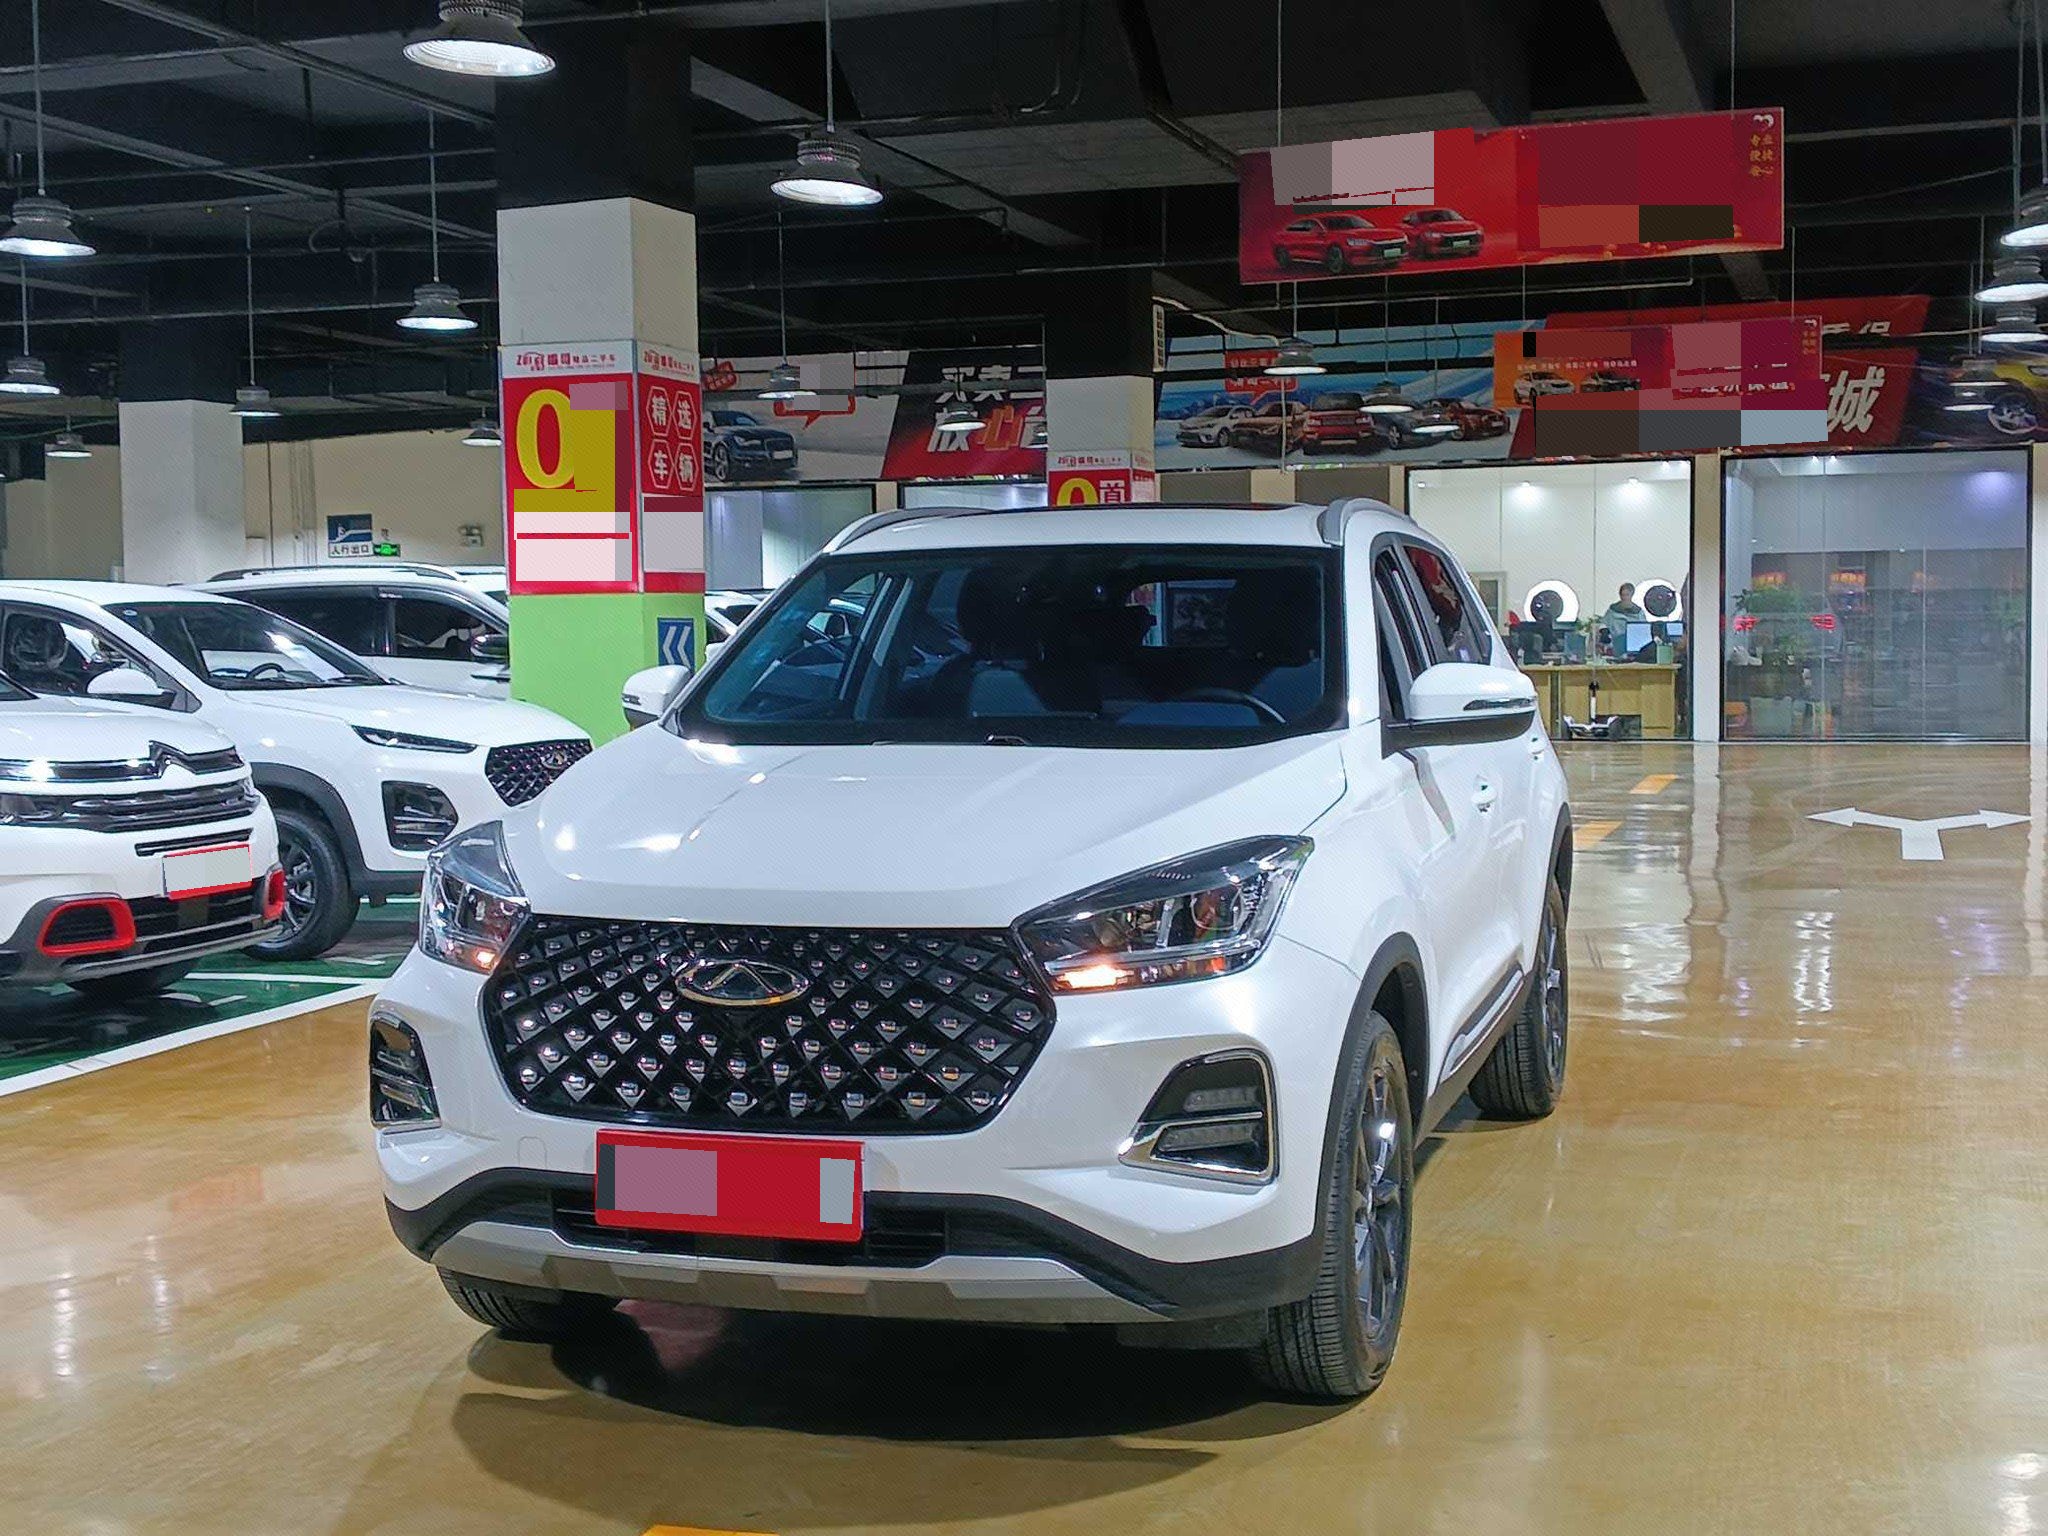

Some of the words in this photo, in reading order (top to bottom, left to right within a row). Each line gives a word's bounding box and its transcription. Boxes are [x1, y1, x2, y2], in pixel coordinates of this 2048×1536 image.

[651, 396, 692, 430] 精选
[653, 450, 694, 483] 车辆
[331, 544, 370, 555] 人行出口
